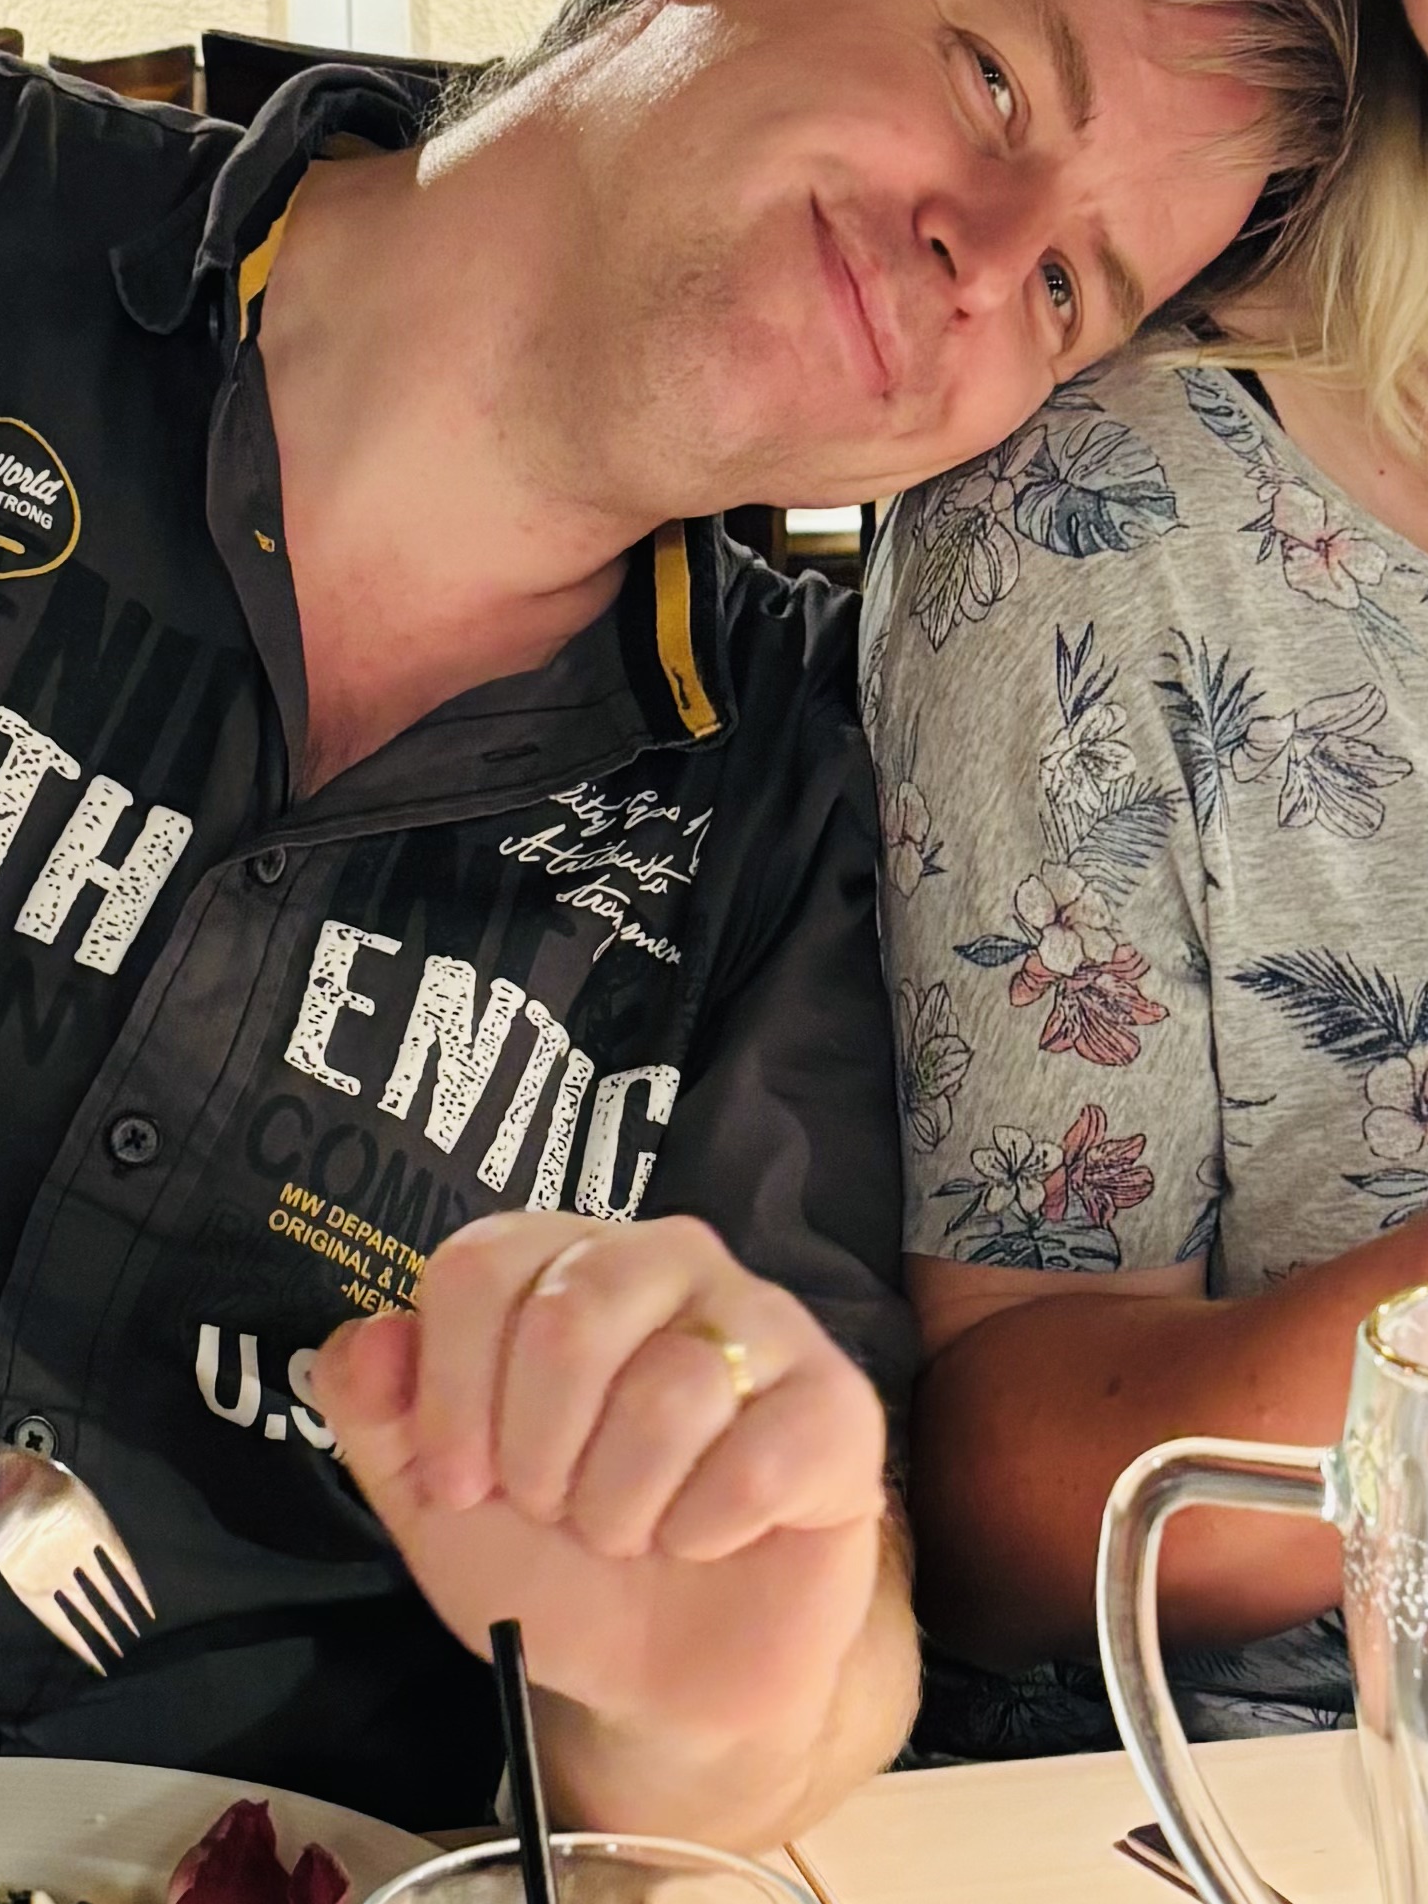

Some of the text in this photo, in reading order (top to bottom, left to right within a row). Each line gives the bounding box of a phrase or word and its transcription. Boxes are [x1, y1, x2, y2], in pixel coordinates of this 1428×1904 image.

[279, 1182, 326, 1217] MW
[268, 1209, 371, 1280] ORIGINAL
[377, 1266, 393, 1290] &
